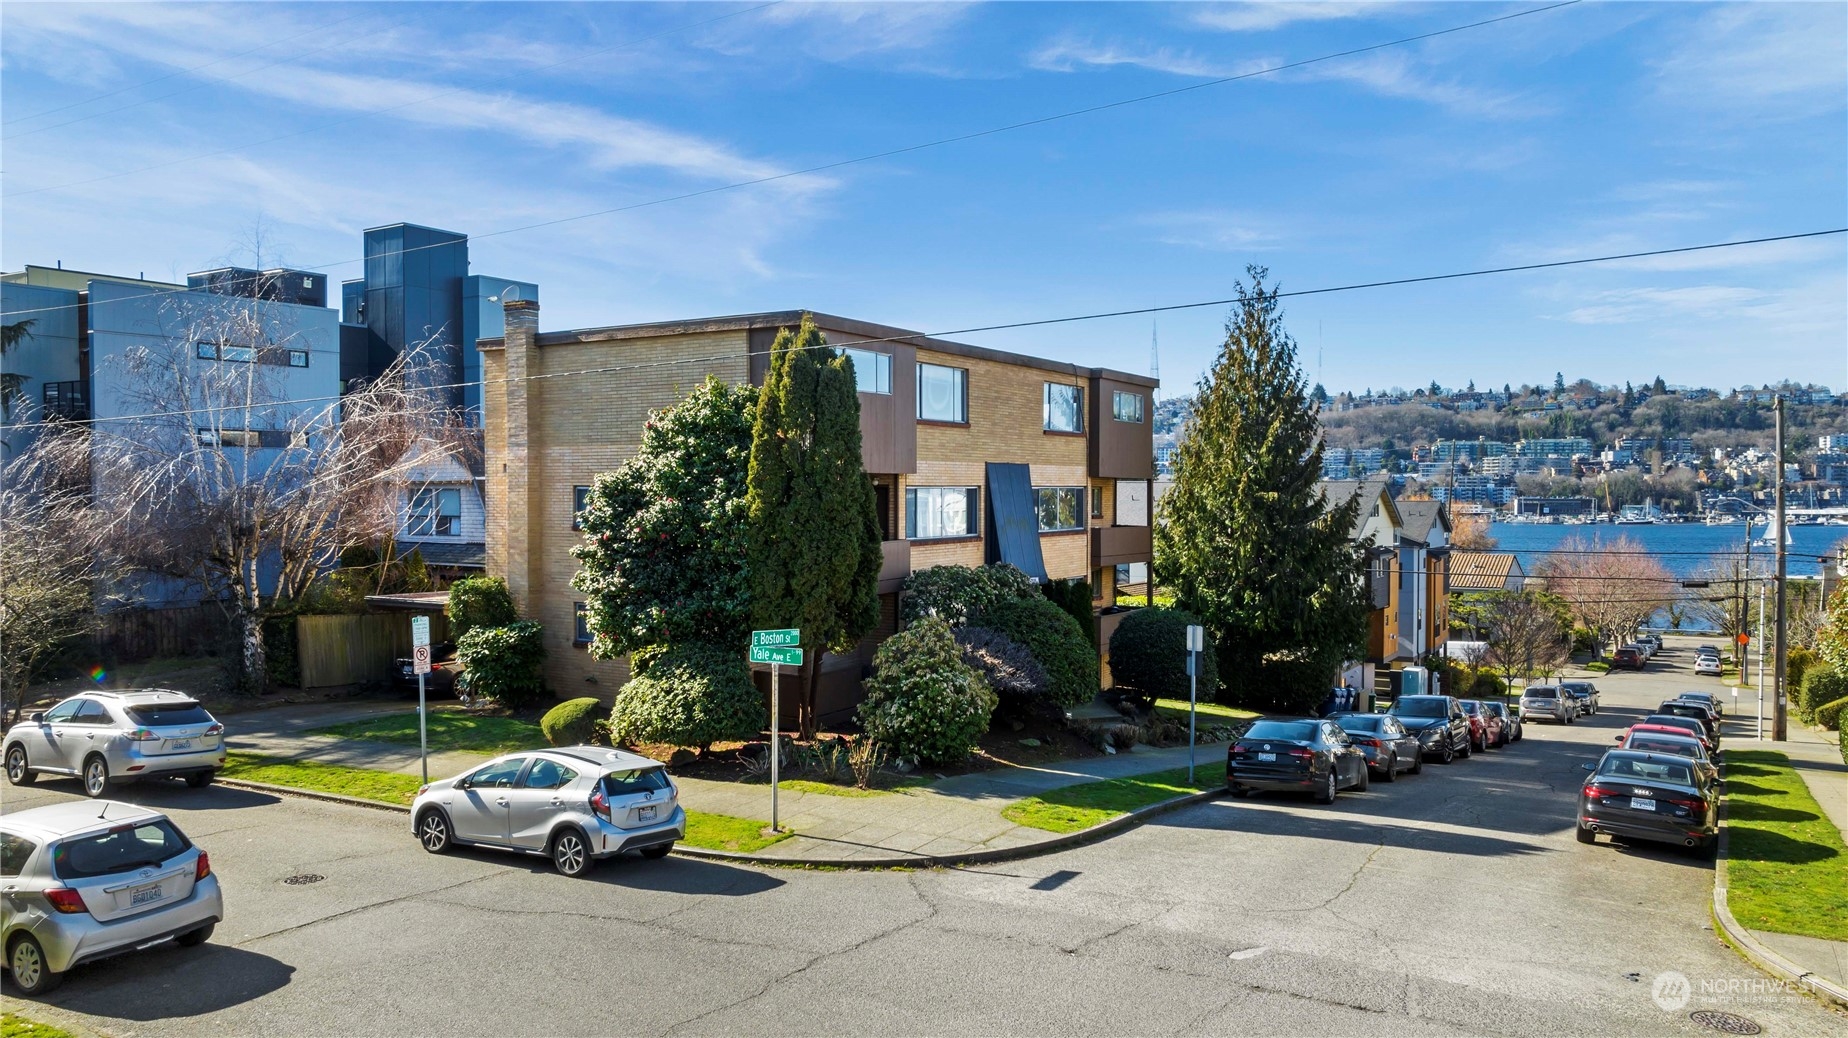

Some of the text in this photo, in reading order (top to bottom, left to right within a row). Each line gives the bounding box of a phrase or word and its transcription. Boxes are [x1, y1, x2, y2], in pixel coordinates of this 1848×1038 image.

[754, 636, 758, 645] E
[760, 632, 784, 645] Boston
[752, 647, 770, 660] Yale
[772, 652, 784, 661] Ave
[786, 653, 792, 662] E
